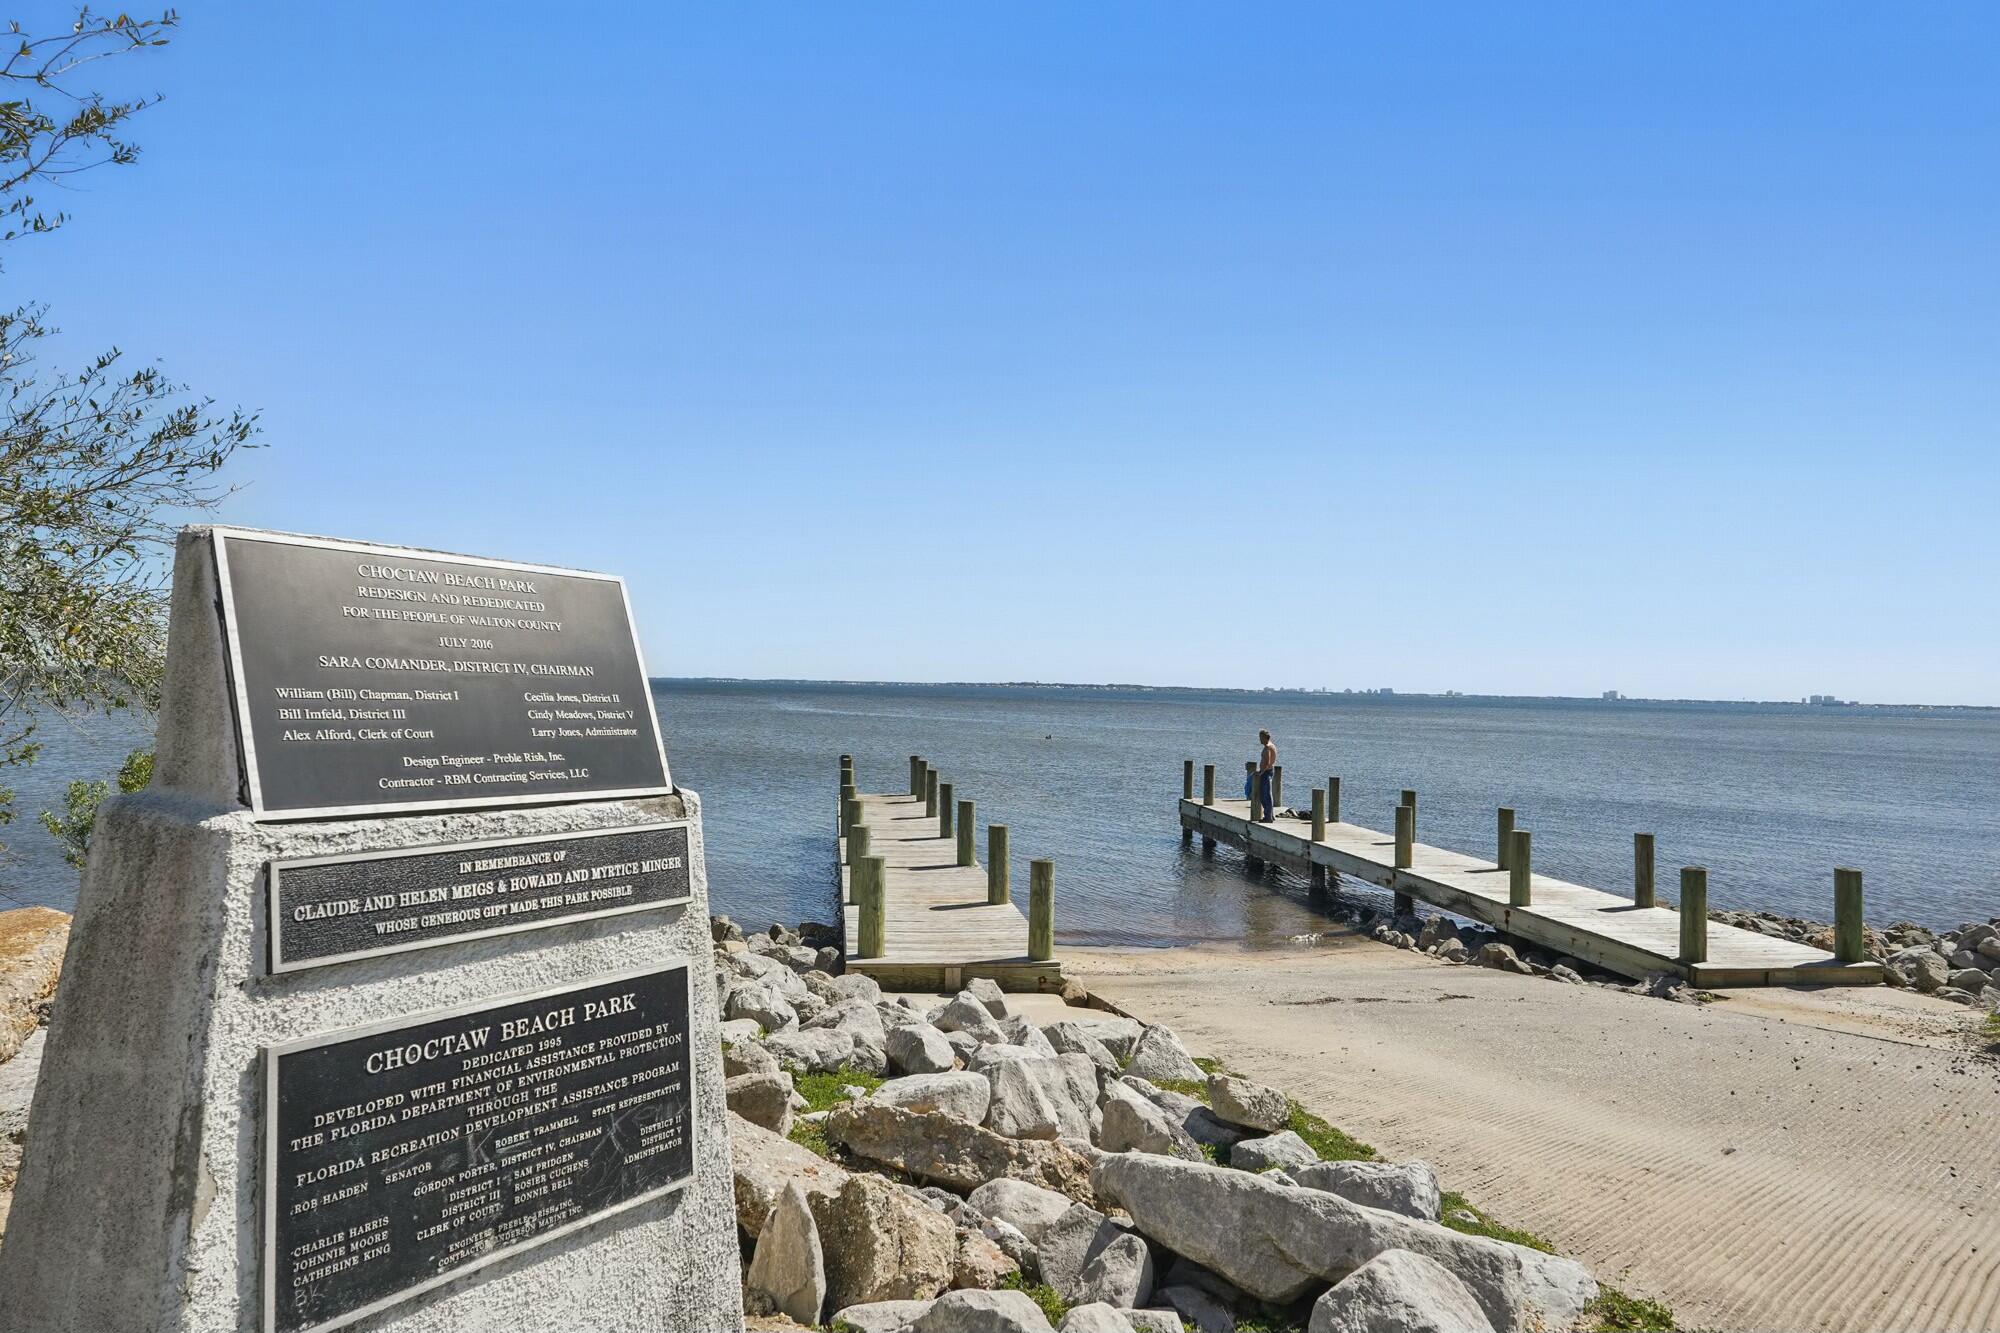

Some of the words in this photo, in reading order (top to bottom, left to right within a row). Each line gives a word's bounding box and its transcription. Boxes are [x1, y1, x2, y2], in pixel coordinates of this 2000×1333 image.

[358, 564, 439, 584] CHOCTAW
[444, 573, 495, 589] BEACH
[499, 579, 536, 593] PARK
[358, 586, 426, 602] REDESIGN
[431, 593, 459, 604] AND
[463, 596, 544, 611] REDEDICATED
[342, 606, 370, 617] FOR
[372, 609, 400, 620] THE
[402, 611, 447, 623] PEOPLE
[450, 614, 465, 624] OF
[468, 615, 515, 628] WALTON
[518, 620, 561, 631] COUNTY
[438, 637, 467, 648] JULY
[471, 639, 493, 649] 2016
[319, 656, 361, 668] SARA
[365, 658, 451, 672] COMANDER,
[454, 660, 510, 673] DISTRICT
[513, 663, 529, 675] IV,
[530, 664, 593, 676] CHAIRMAN
[275, 688, 323, 699] William
[327, 689, 356, 701] (Bill)
[359, 689, 412, 701] Chapman,
[415, 690, 452, 700] District
[453, 691, 459, 700] I
[524, 692, 554, 702] Cecilia
[556, 693, 581, 703] Jones,
[582, 693, 611, 703] District
[611, 694, 620, 702] II
[279, 709, 301, 719] Bill
[304, 709, 346, 720] Imfeld,
[349, 709, 390, 719] District
[393, 709, 406, 719] III
[527, 710, 553, 720] Cindy
[555, 710, 596, 720] Meadows,
[597, 710, 626, 719] District
[627, 710, 634, 719] V
[283, 730, 311, 740] Alex
[315, 729, 356, 741] Alford,
[358, 729, 387, 739] Clerk
[391, 729, 402, 739] of
[404, 729, 434, 739] Court
[531, 727, 556, 738] Larry
[558, 728, 583, 737] Jones,
[585, 727, 638, 736] Administrator
[403, 755, 439, 768] Design
[441, 755, 484, 767] Engineer
[494, 753, 522, 763] Preble
[523, 752, 547, 762] Rish,
[549, 752, 565, 761] Inc.
[379, 776, 434, 788] Contractor
[444, 774, 471, 785] RBM
[474, 771, 528, 783] Contracting
[530, 769, 568, 780] Services,
[569, 768, 589, 778] LLC
[460, 862, 472, 873] IN
[475, 853, 551, 871] REMEMBRANCE
[554, 851, 566, 861] OF
[294, 899, 359, 921] CLAUDE
[363, 894, 395, 912] AND
[399, 887, 448, 906] HELEN
[451, 882, 493, 899] MEIGS
[497, 881, 506, 893] &
[510, 873, 562, 891] HOWARD
[565, 869, 589, 883] AND
[592, 863, 638, 879] MYRTICE
[641, 857, 681, 872] MINGER
[375, 918, 418, 934] WHOSE
[421, 907, 480, 927] GENEROUS
[483, 904, 507, 918] GIFT
[510, 900, 538, 914] MADE
[541, 896, 563, 909] THIS
[565, 892, 589, 905] PARK
[591, 885, 632, 901] POSSIBLE
[366, 1026, 490, 1073] CHOCTAW
[500, 1008, 575, 1041] BEACH
[583, 993, 636, 1021] PARK
[463, 1043, 533, 1070] DEDICATED
[538, 1037, 561, 1051] 1995
[314, 1094, 404, 1127] DEVELOPED
[410, 1082, 446, 1101] WITH
[452, 1062, 521, 1089] FINANCIAL
[526, 1042, 595, 1069] ASSISTANCE
[599, 1028, 652, 1049] PROVIDED
[656, 1023, 669, 1034] BY
[290, 1133, 323, 1151] THE
[331, 1113, 396, 1141] FLORIDA
[401, 1086, 491, 1120] DEPARTMENT
[497, 1080, 512, 1093] OF
[518, 1053, 615, 1087] ENVIRONMENTAL
[619, 1033, 682, 1058] PROTECTION
[467, 1091, 529, 1117] THROUGH
[535, 1083, 558, 1097] THE
[296, 1157, 365, 1187] FLORIDA
[371, 1127, 460, 1164] RECREATION
[466, 1099, 557, 1134] DEVELOPMENT
[561, 1077, 628, 1105] ASSISTANCE
[632, 1062, 679, 1084] PROGRAM
[495, 1131, 530, 1149] ROBERT
[534, 1115, 579, 1136] TRAMMELL
[592, 1104, 616, 1117] STATE
[619, 1082, 680, 1109] REPRESENTATIVE
[640, 1118, 673, 1136] DISTRICT
[675, 1115, 681, 1124] II
[623, 1137, 682, 1165] ADMINISTRATOR
[641, 1130, 674, 1147] DISTRICT
[413, 1176, 454, 1197] GORDON
[459, 1162, 497, 1181] PORTER,
[501, 1147, 542, 1167] DISTRICT
[559, 1127, 602, 1147] CHAIRMAN
[514, 1168, 532, 1180] SAM
[536, 1152, 574, 1174] PRIDGEN
[514, 1175, 546, 1192] ROSIER
[549, 1159, 589, 1179] CUCHENS
[294, 1198, 318, 1214] ROB
[322, 1183, 368, 1204] HARDEN
[385, 1162, 432, 1184] SENATOR
[450, 1180, 493, 1201] DISTRICT
[496, 1177, 500, 1185] I
[514, 1186, 548, 1205] RONNIE
[551, 1178, 573, 1191] BELL
[442, 1196, 485, 1218] DISTRICT
[489, 1190, 500, 1201] III
[293, 1232, 345, 1257] CHARLIE
[349, 1216, 389, 1238] HARRIS
[416, 1221, 449, 1240] CLERK
[453, 1215, 466, 1227] OF
[293, 1247, 345, 1272] JOHNNIE
[350, 1231, 389, 1252] MOORE
[293, 1255, 359, 1287] CATHERINE
[364, 1244, 391, 1261] KING
[438, 1239, 492, 1267] CONTRACTO
